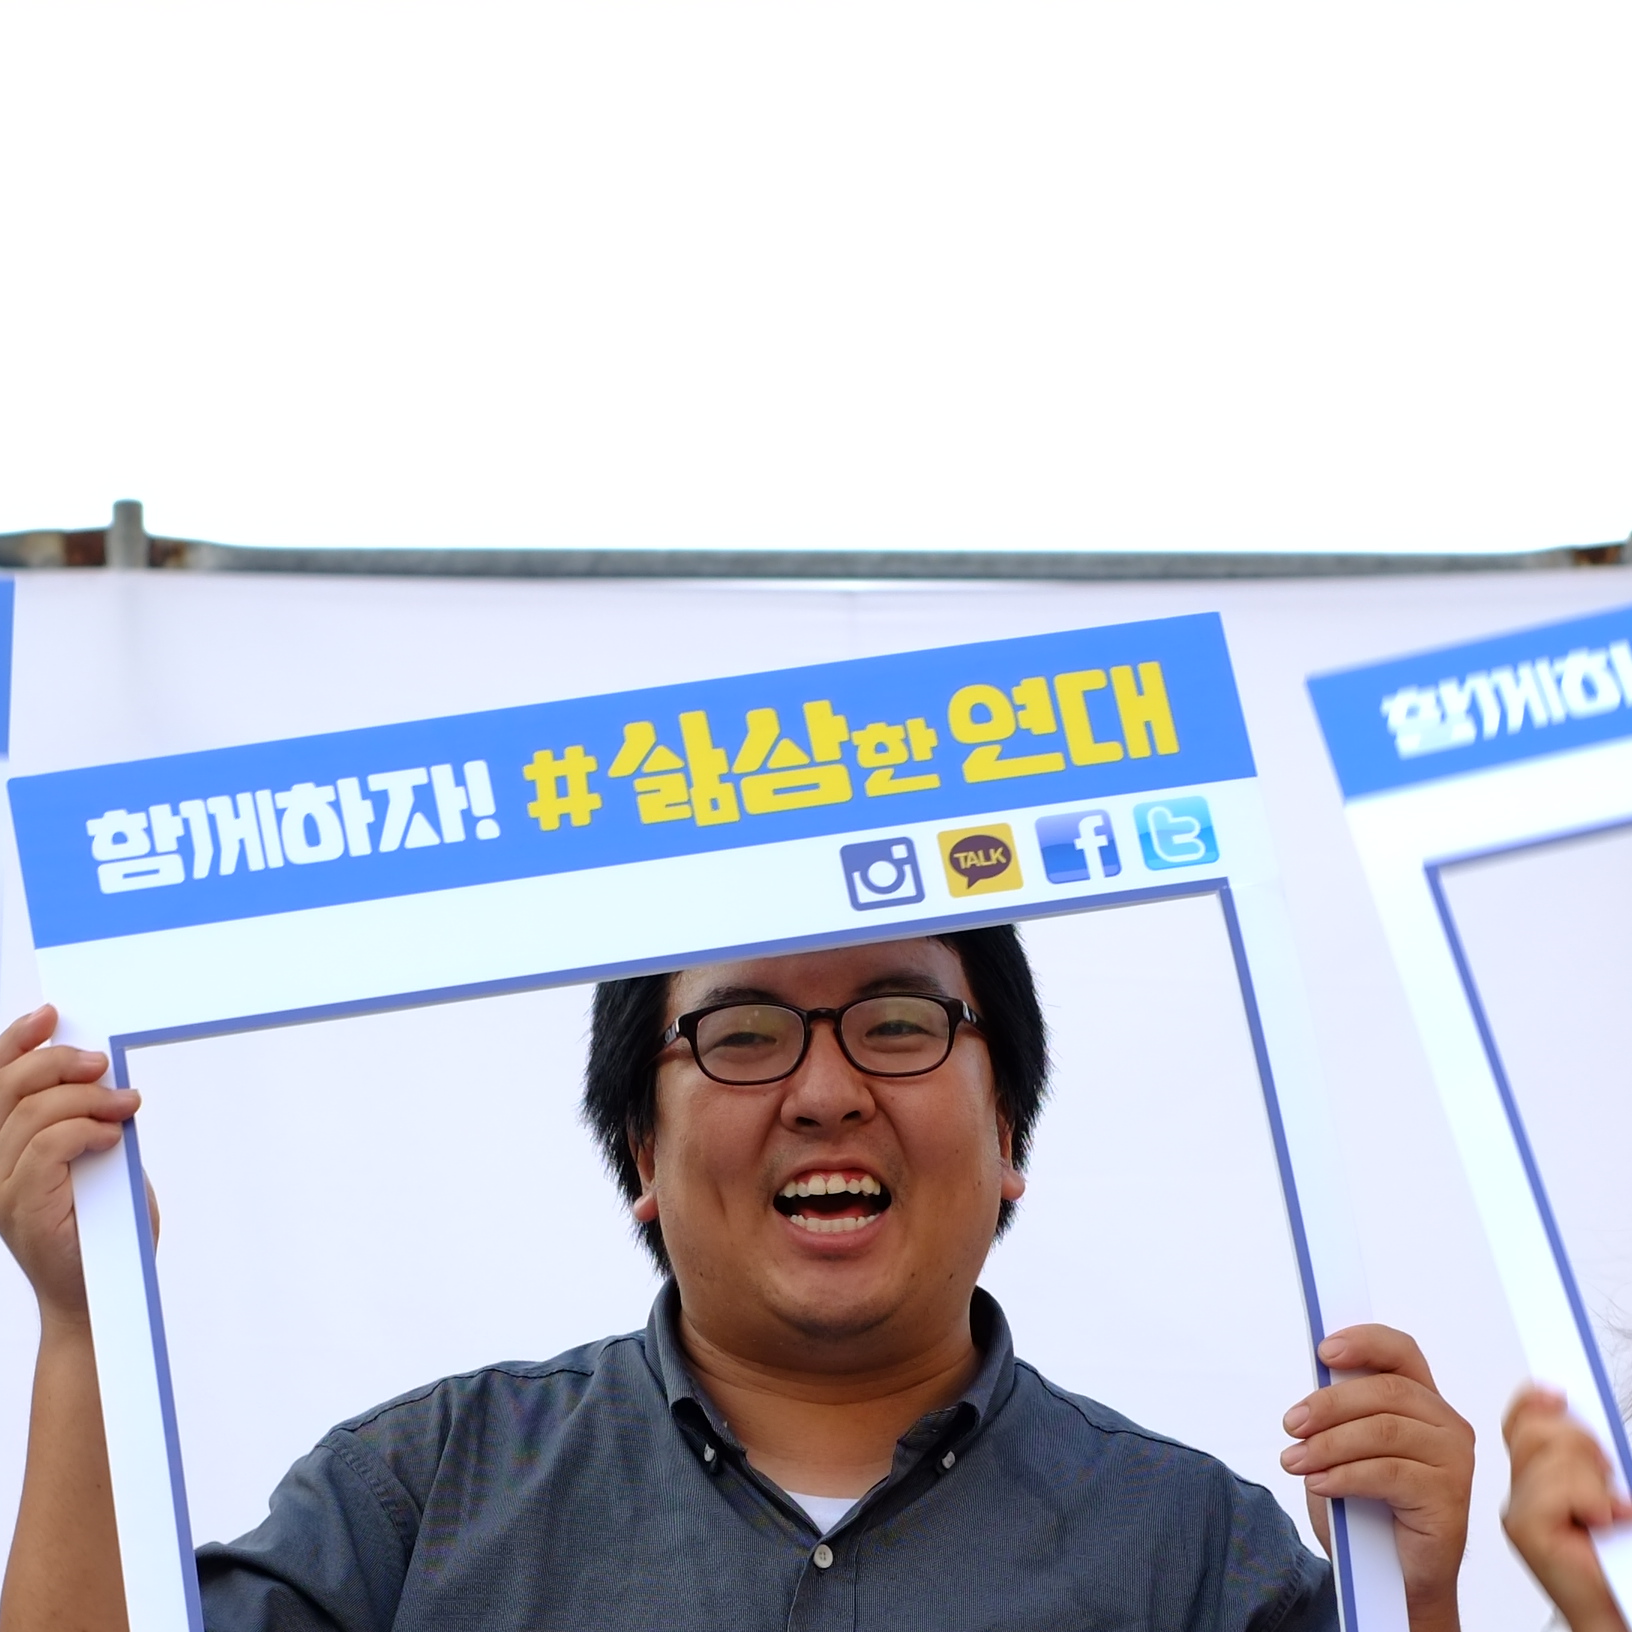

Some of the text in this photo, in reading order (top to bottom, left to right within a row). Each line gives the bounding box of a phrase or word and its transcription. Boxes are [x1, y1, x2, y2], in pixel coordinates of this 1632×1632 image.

[86, 760, 501, 894] 함께하자!
[948, 661, 1180, 784] 연대
[953, 846, 1008, 870] TALK
